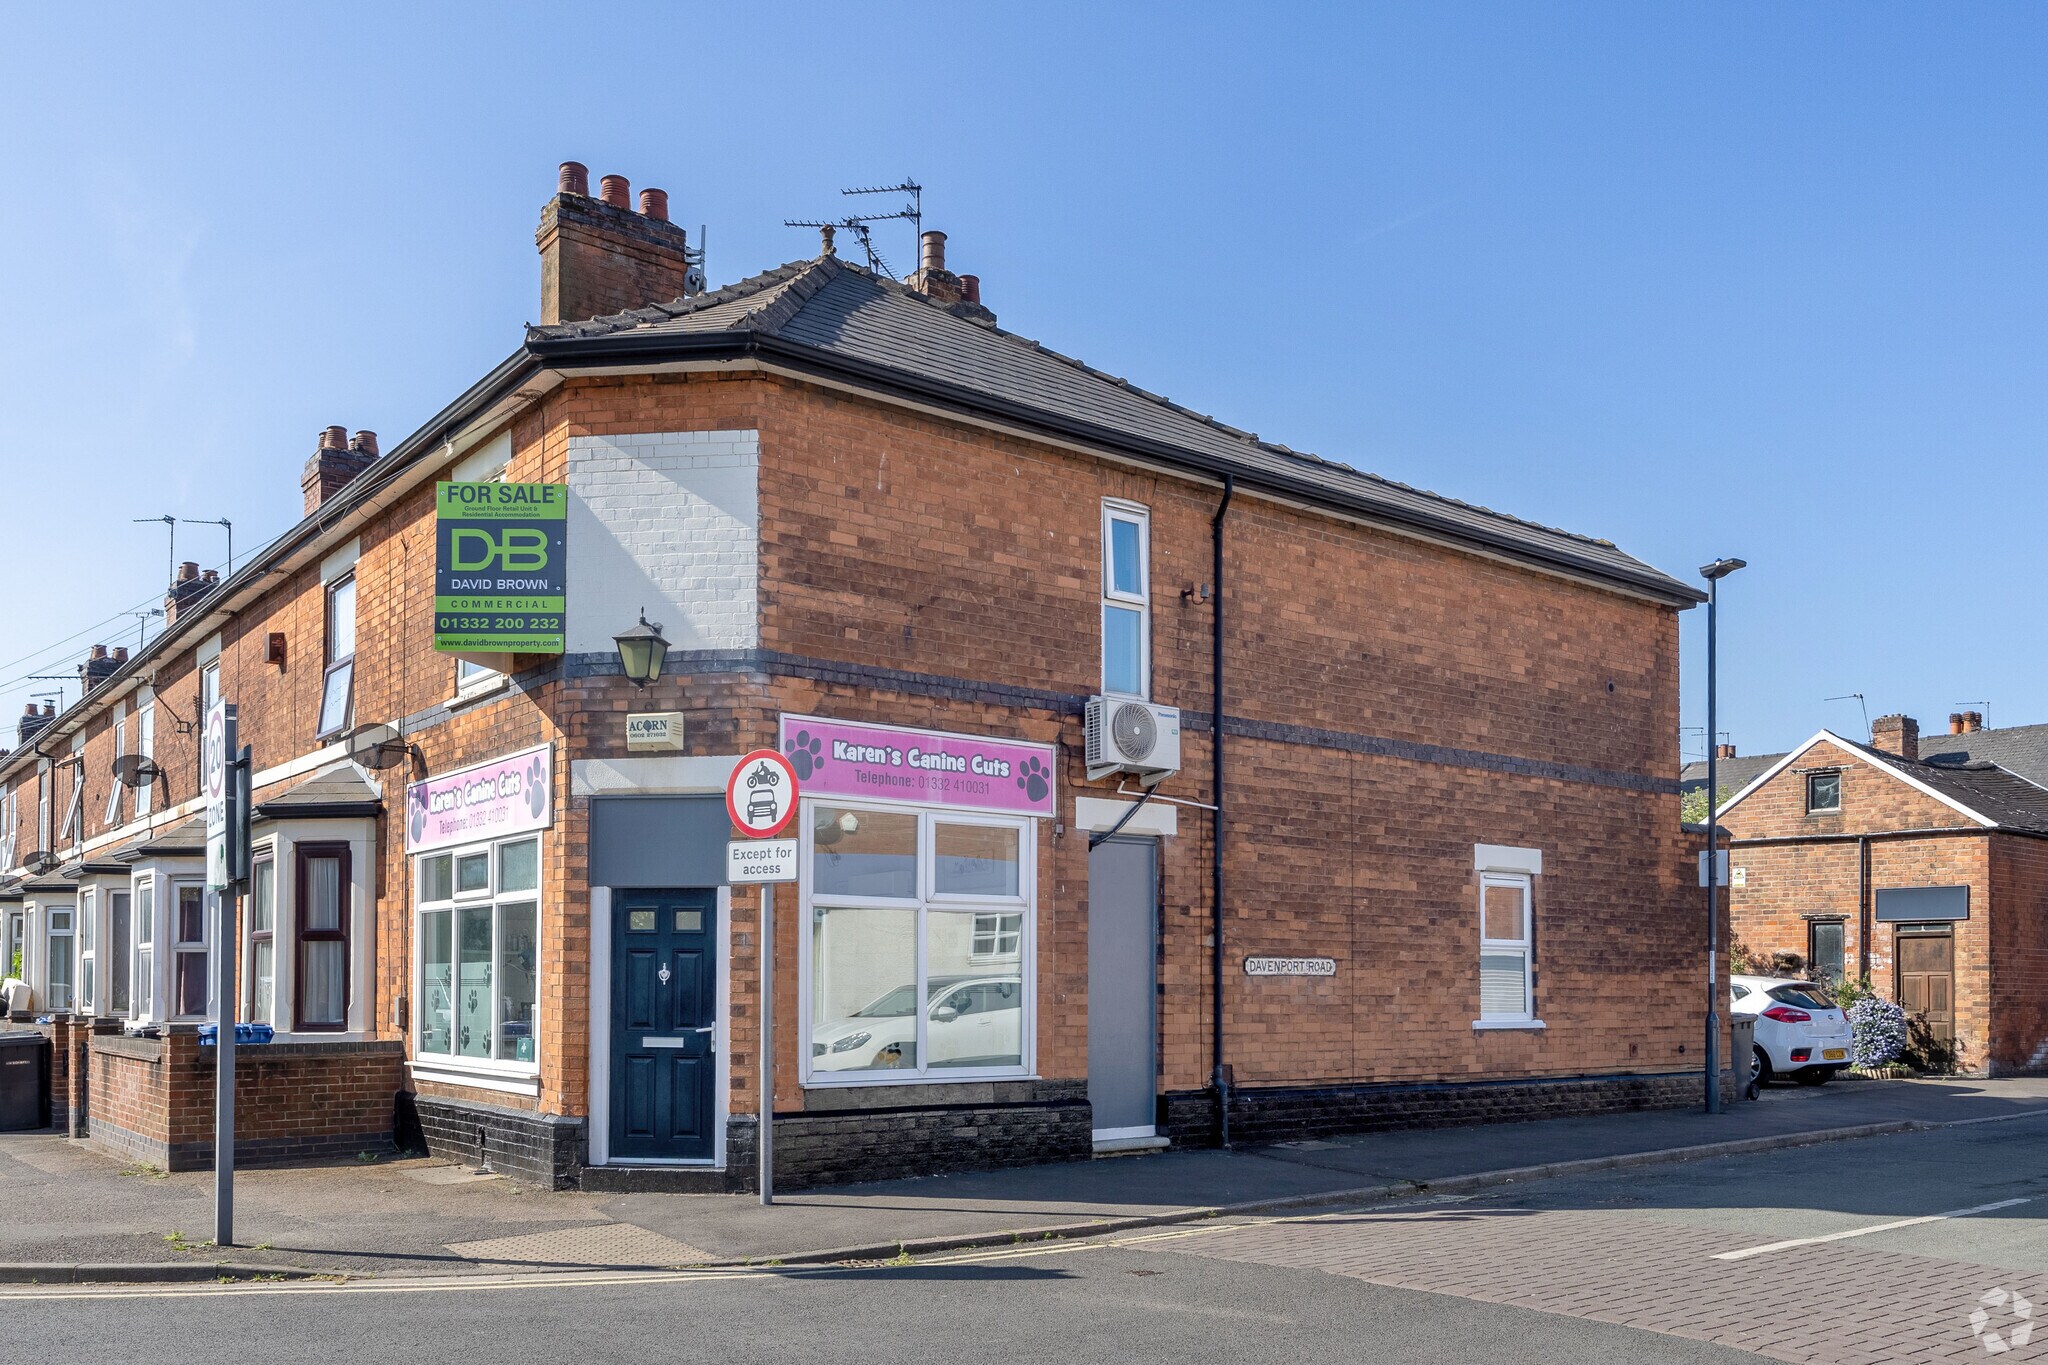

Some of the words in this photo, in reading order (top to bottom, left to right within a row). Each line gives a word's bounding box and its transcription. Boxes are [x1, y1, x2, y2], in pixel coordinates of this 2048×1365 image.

[448, 485, 491, 504] FOR
[498, 485, 555, 504] SALE
[451, 528, 549, 572] DB
[451, 579, 492, 590] DAVID
[497, 579, 548, 590] BROWN
[451, 600, 548, 609] COMMERCIAL
[440, 618, 490, 629] 01332
[495, 618, 525, 629] 200
[529, 618, 559, 629] 232
[440, 638, 559, 648] www.davidbrownproperty.com
[629, 720, 667, 732] ACORN
[210, 735, 222, 774] 20
[833, 739, 902, 766] Karen's
[907, 747, 966, 773] Canine
[971, 755, 1011, 778] Cuts
[855, 769, 915, 788] Telephone:
[918, 777, 951, 791] 01332
[953, 779, 990, 795] 410031
[430, 786, 462, 815] Karen's
[464, 778, 496, 807] Canine
[498, 770, 521, 799] Cuts
[208, 800, 224, 828] ZONE
[439, 818, 468, 835] Telephone:
[469, 810, 487, 829] 01332
[733, 847, 772, 860] Except
[776, 847, 792, 858] for
[743, 865, 781, 875] access
[1249, 960, 1305, 972] DAVENPORT
[1308, 961, 1332, 972] ROAD
